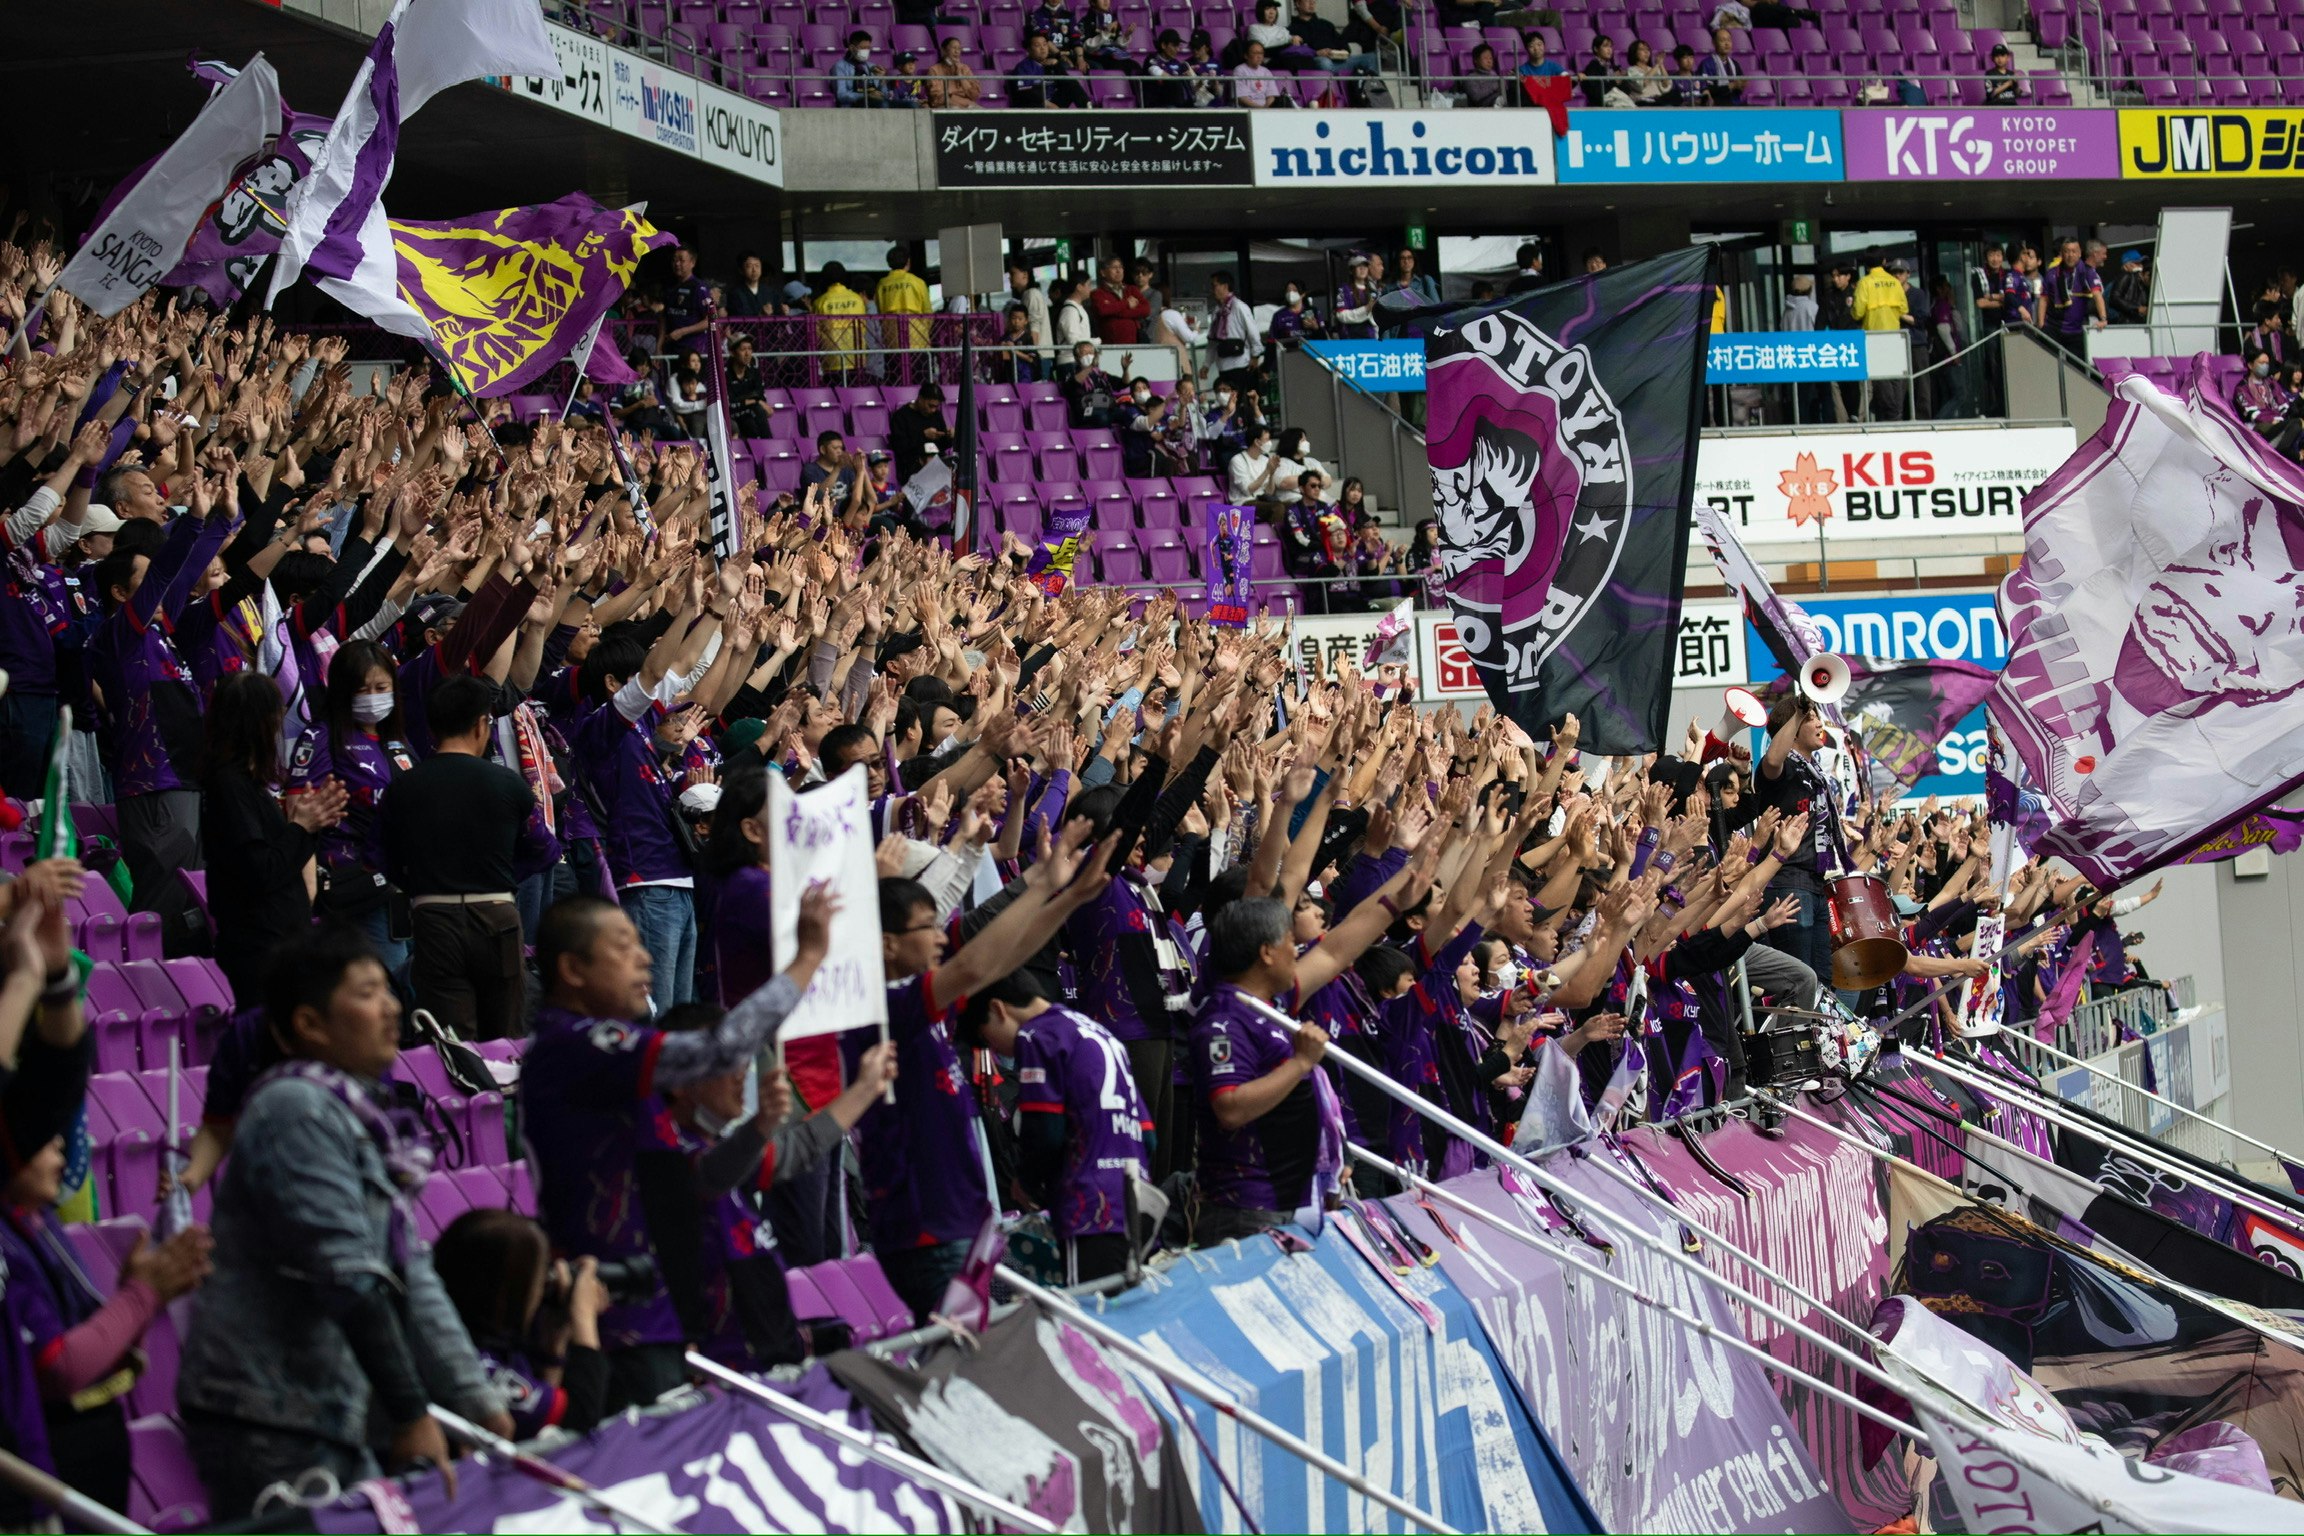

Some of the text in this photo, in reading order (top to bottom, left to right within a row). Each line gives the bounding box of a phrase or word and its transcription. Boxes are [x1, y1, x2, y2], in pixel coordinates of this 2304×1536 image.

[706, 103, 775, 166] KOKUYO
[2002, 116, 2057, 132] KYOTO
[656, 125, 695, 151] CORPORATION
[941, 125, 1246, 153] ダイワ・セキュリティー・システム
[1271, 120, 1538, 177] nichicon
[1642, 129, 1833, 166] ハウツーホーム
[1884, 115, 1993, 176] KTG
[2003, 137, 2078, 153] TOYOPET
[2133, 115, 2254, 172] JMD
[2004, 159, 2058, 175] GROUP
[129, 230, 163, 257] KYOTO
[91, 233, 163, 289] SANGA
[882, 282, 912, 293] STAFF
[827, 300, 857, 311] STAFF
[1842, 450, 1935, 487] KIS
[1953, 468, 2048, 483] ケイアイエス物流株式会社
[1788, 481, 1829, 497] KIS
